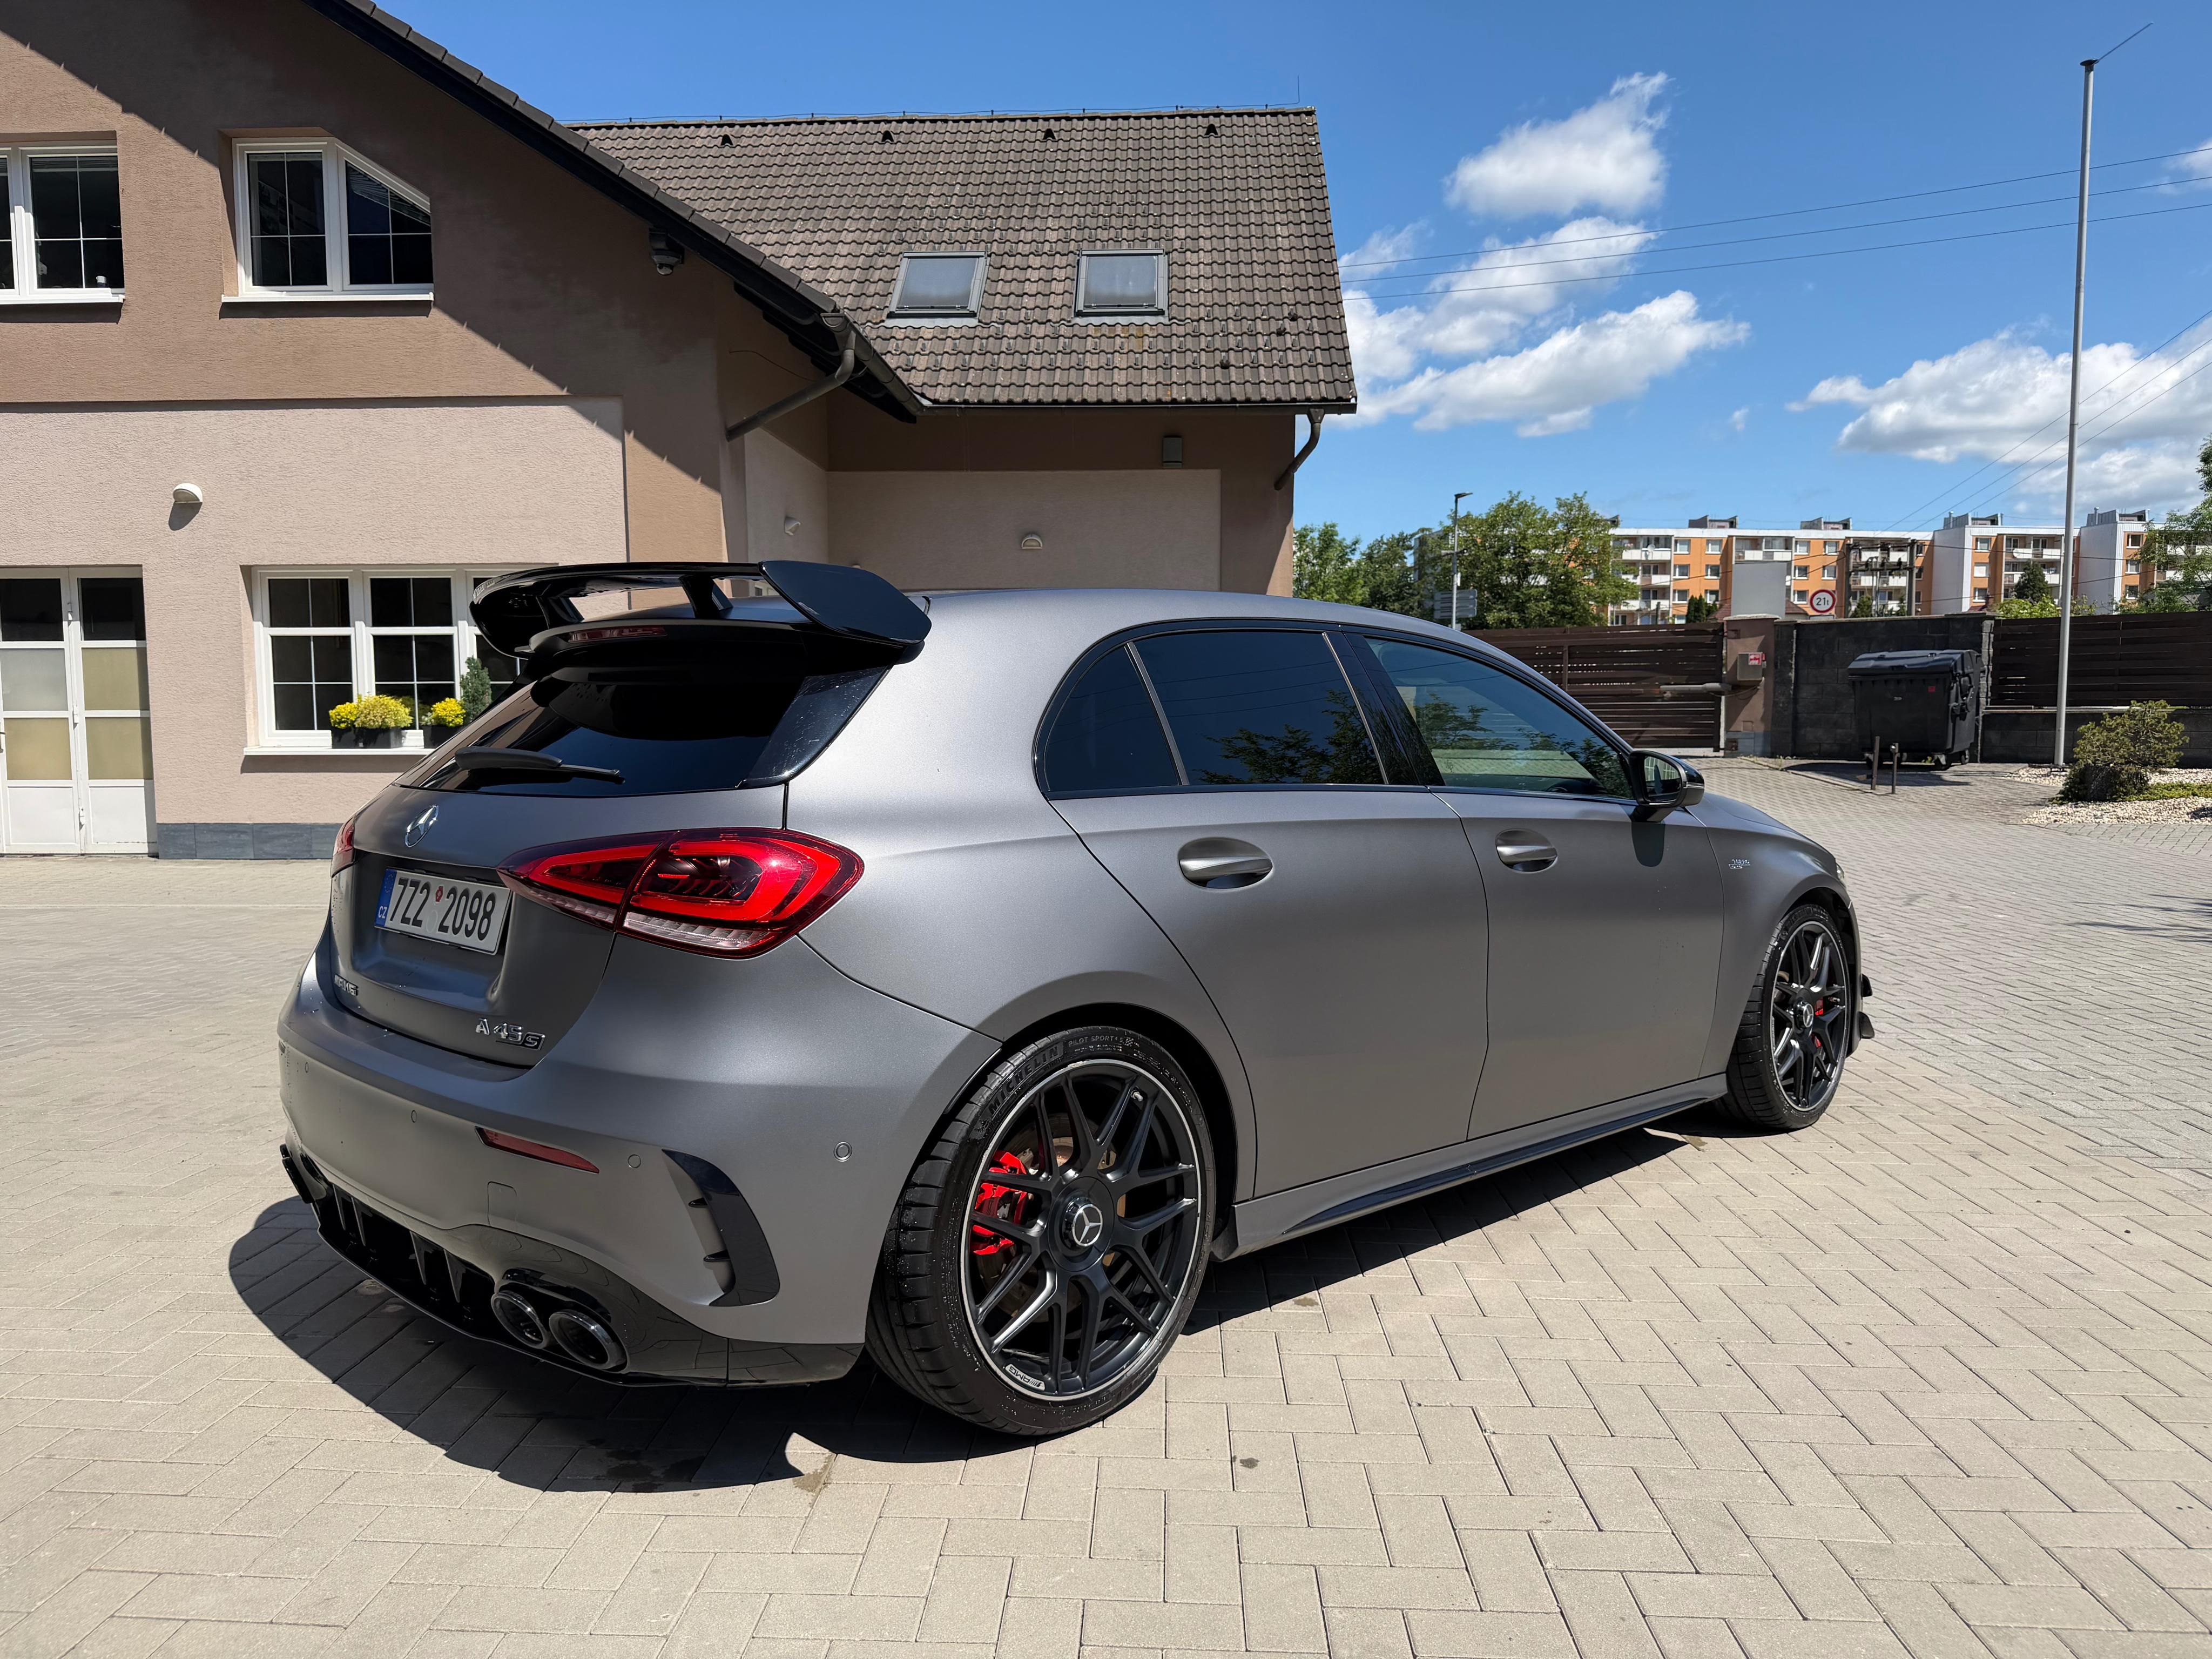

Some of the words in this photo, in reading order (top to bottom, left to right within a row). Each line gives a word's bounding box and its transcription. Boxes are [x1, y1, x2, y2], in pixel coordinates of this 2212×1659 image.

[378, 905, 388, 919] CZ
[389, 876, 431, 928] 7Z2
[437, 885, 496, 941] 2098
[1068, 1036, 1089, 1047] PILOT
[988, 1046, 1058, 1115] MICHELIN
[1008, 1365, 1031, 1384] AMG
